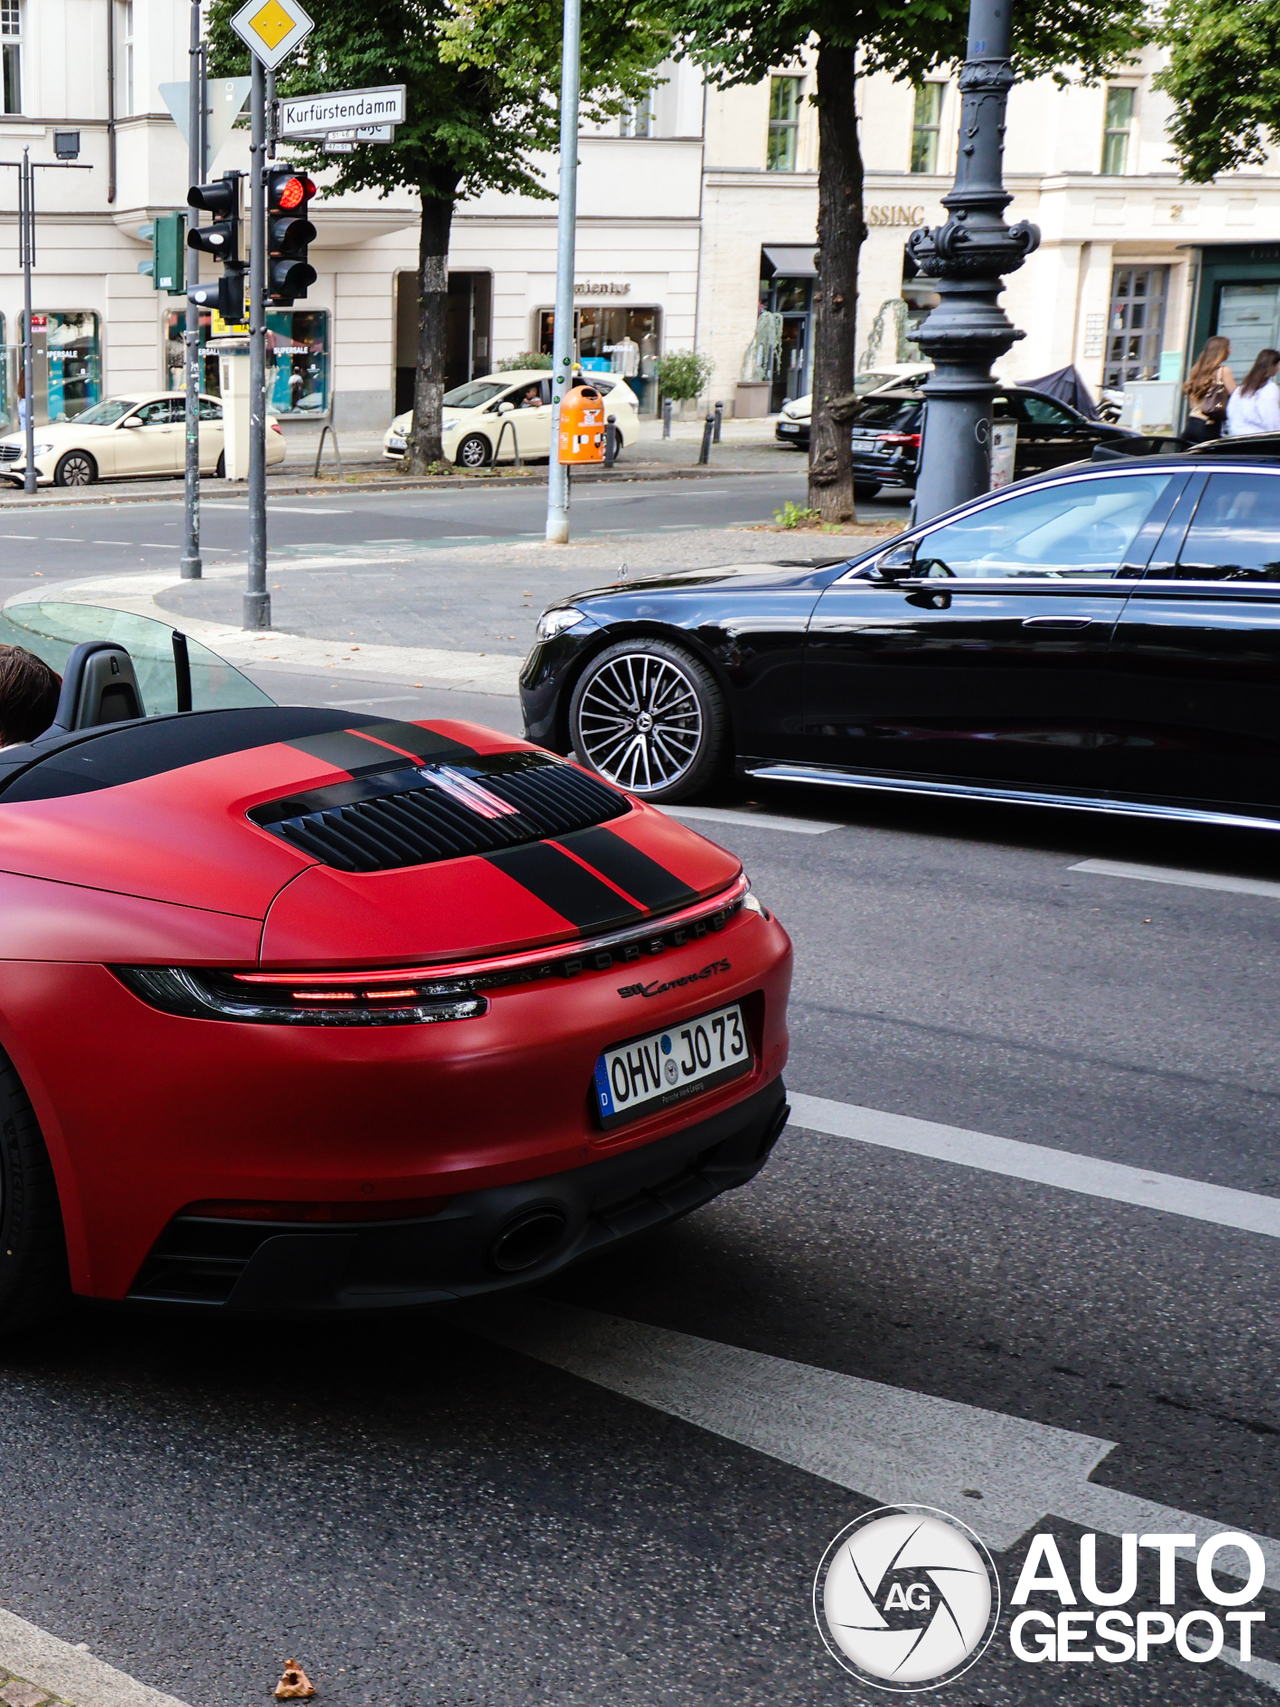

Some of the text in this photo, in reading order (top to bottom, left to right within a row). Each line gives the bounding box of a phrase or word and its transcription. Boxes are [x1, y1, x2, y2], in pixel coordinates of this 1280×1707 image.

[286, 99, 397, 123] Kurfürstendamm
[865, 205, 925, 226] SSING
[273, 346, 308, 355] SUPERSALE
[603, 344, 633, 353] SUPERSALE
[564, 915, 725, 977] PORSCHE
[617, 958, 732, 998] 911 Carrera GTS
[611, 1011, 744, 1102] OHV JO 73
[600, 1092, 609, 1106] D
